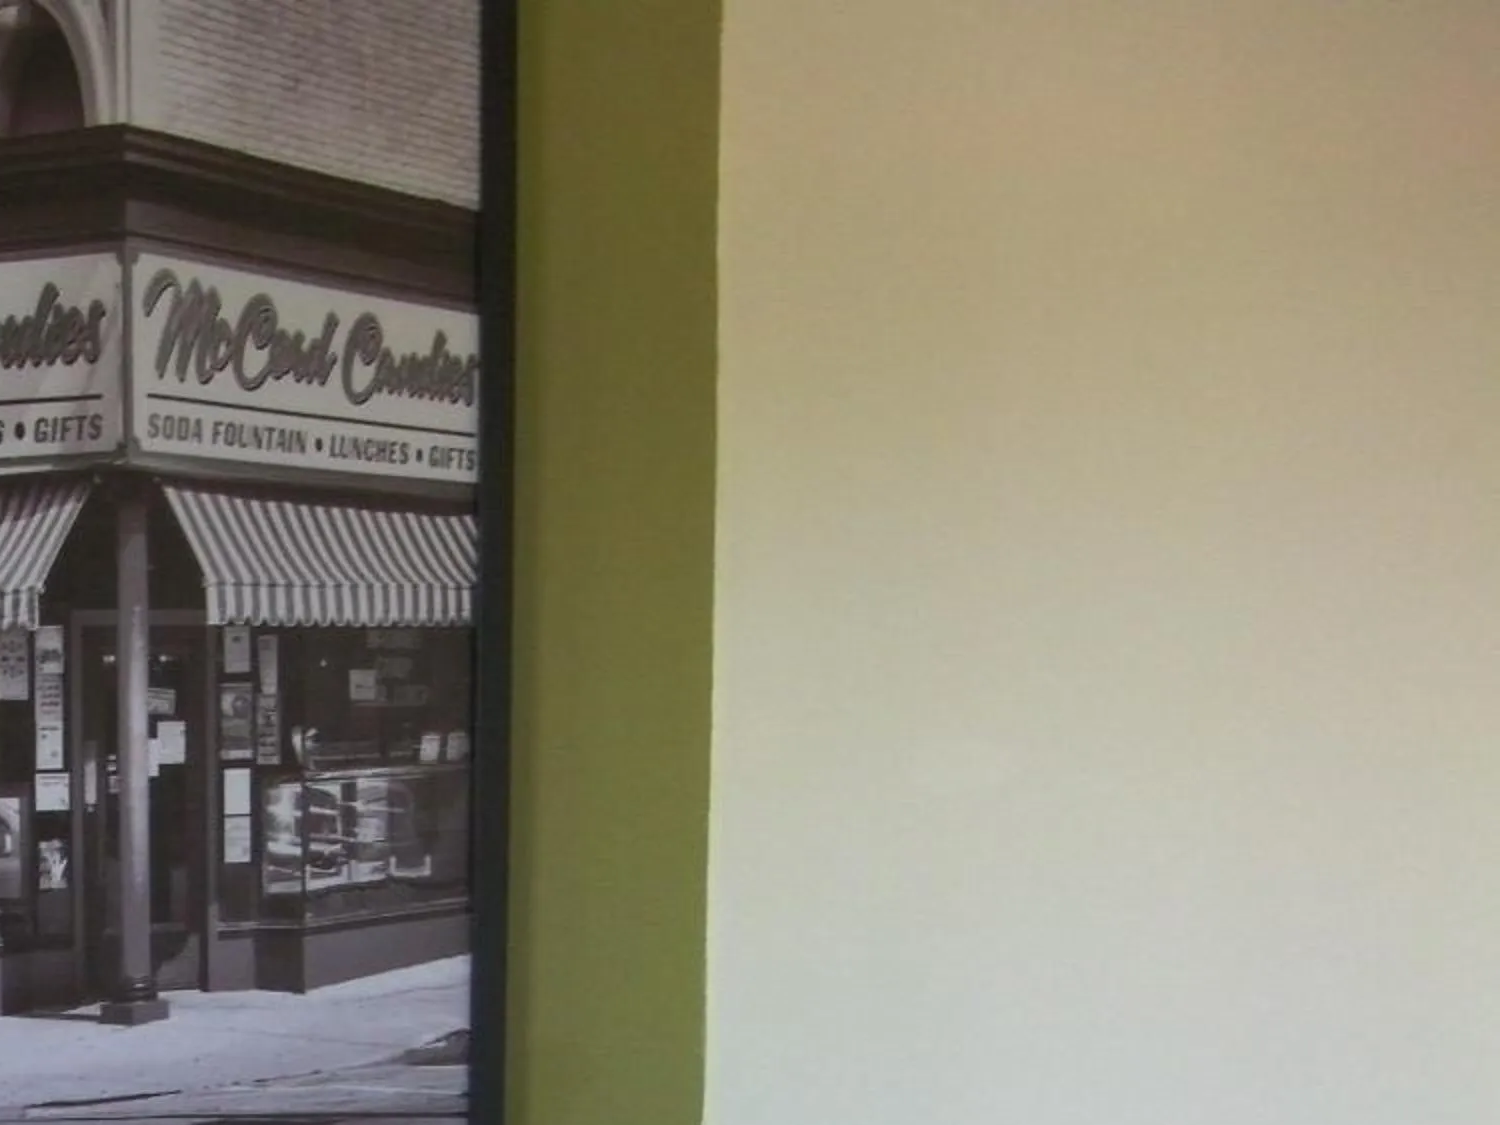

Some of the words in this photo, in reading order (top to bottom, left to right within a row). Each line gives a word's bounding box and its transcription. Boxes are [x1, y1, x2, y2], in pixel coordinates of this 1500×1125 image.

[341, 311, 479, 407] Candies
[34, 413, 103, 443] GIFTS
[147, 412, 203, 442] SODA
[211, 420, 308, 455] FOUNTAIN
[328, 431, 410, 465] LUNCHES
[428, 444, 476, 472] GIFTS
